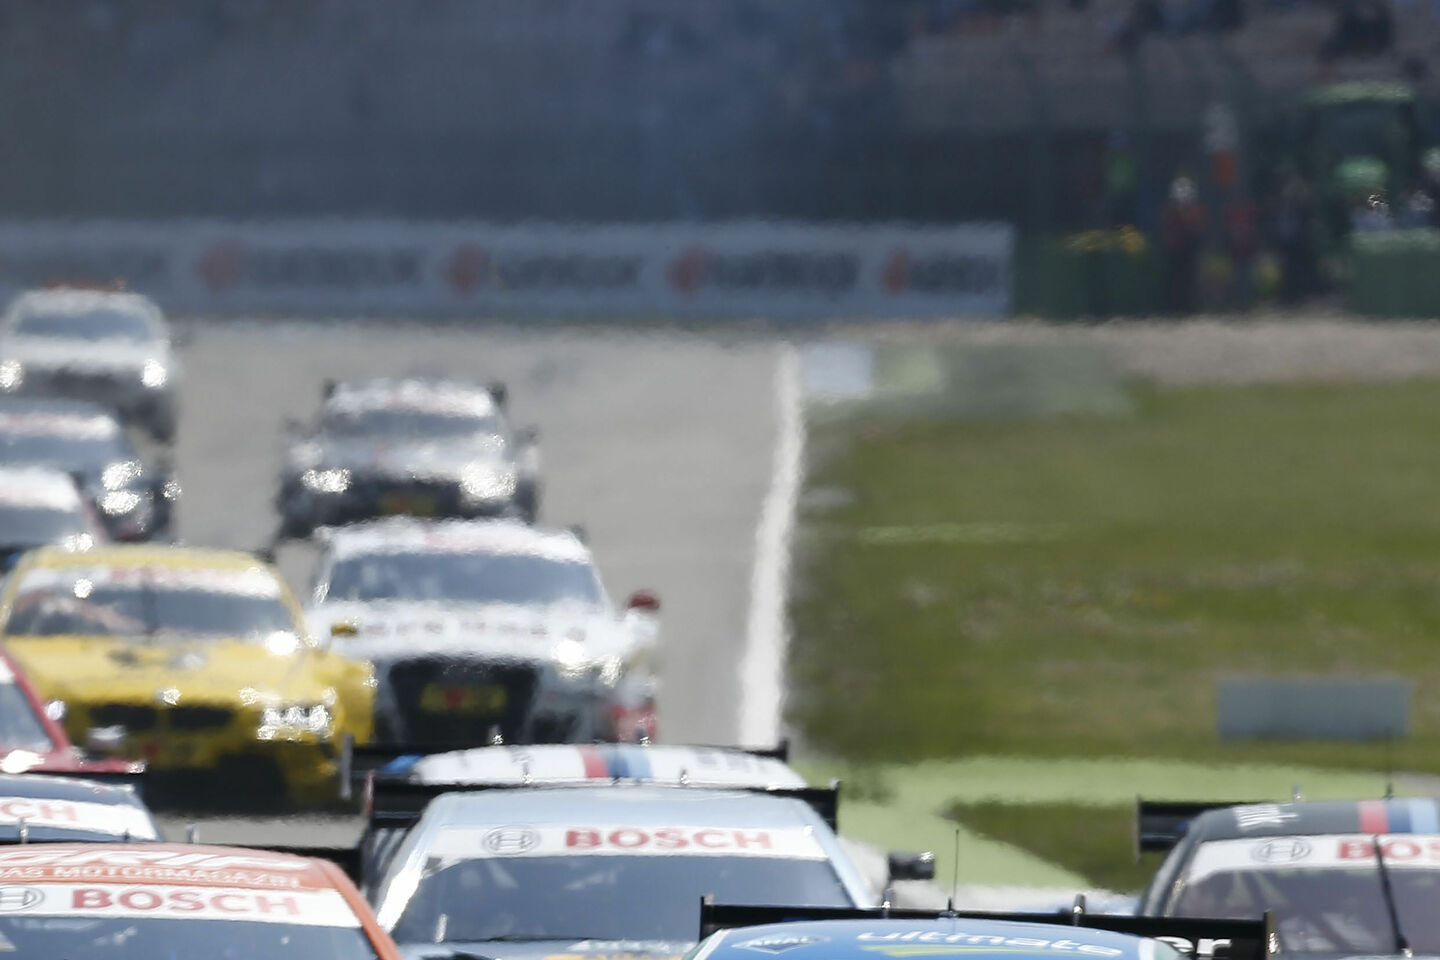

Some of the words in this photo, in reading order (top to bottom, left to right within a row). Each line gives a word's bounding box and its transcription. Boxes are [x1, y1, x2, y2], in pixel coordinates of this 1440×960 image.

[565, 829, 774, 850] BOSCH
[70, 887, 301, 915] BOSCH
[857, 930, 1124, 957] ultimate
